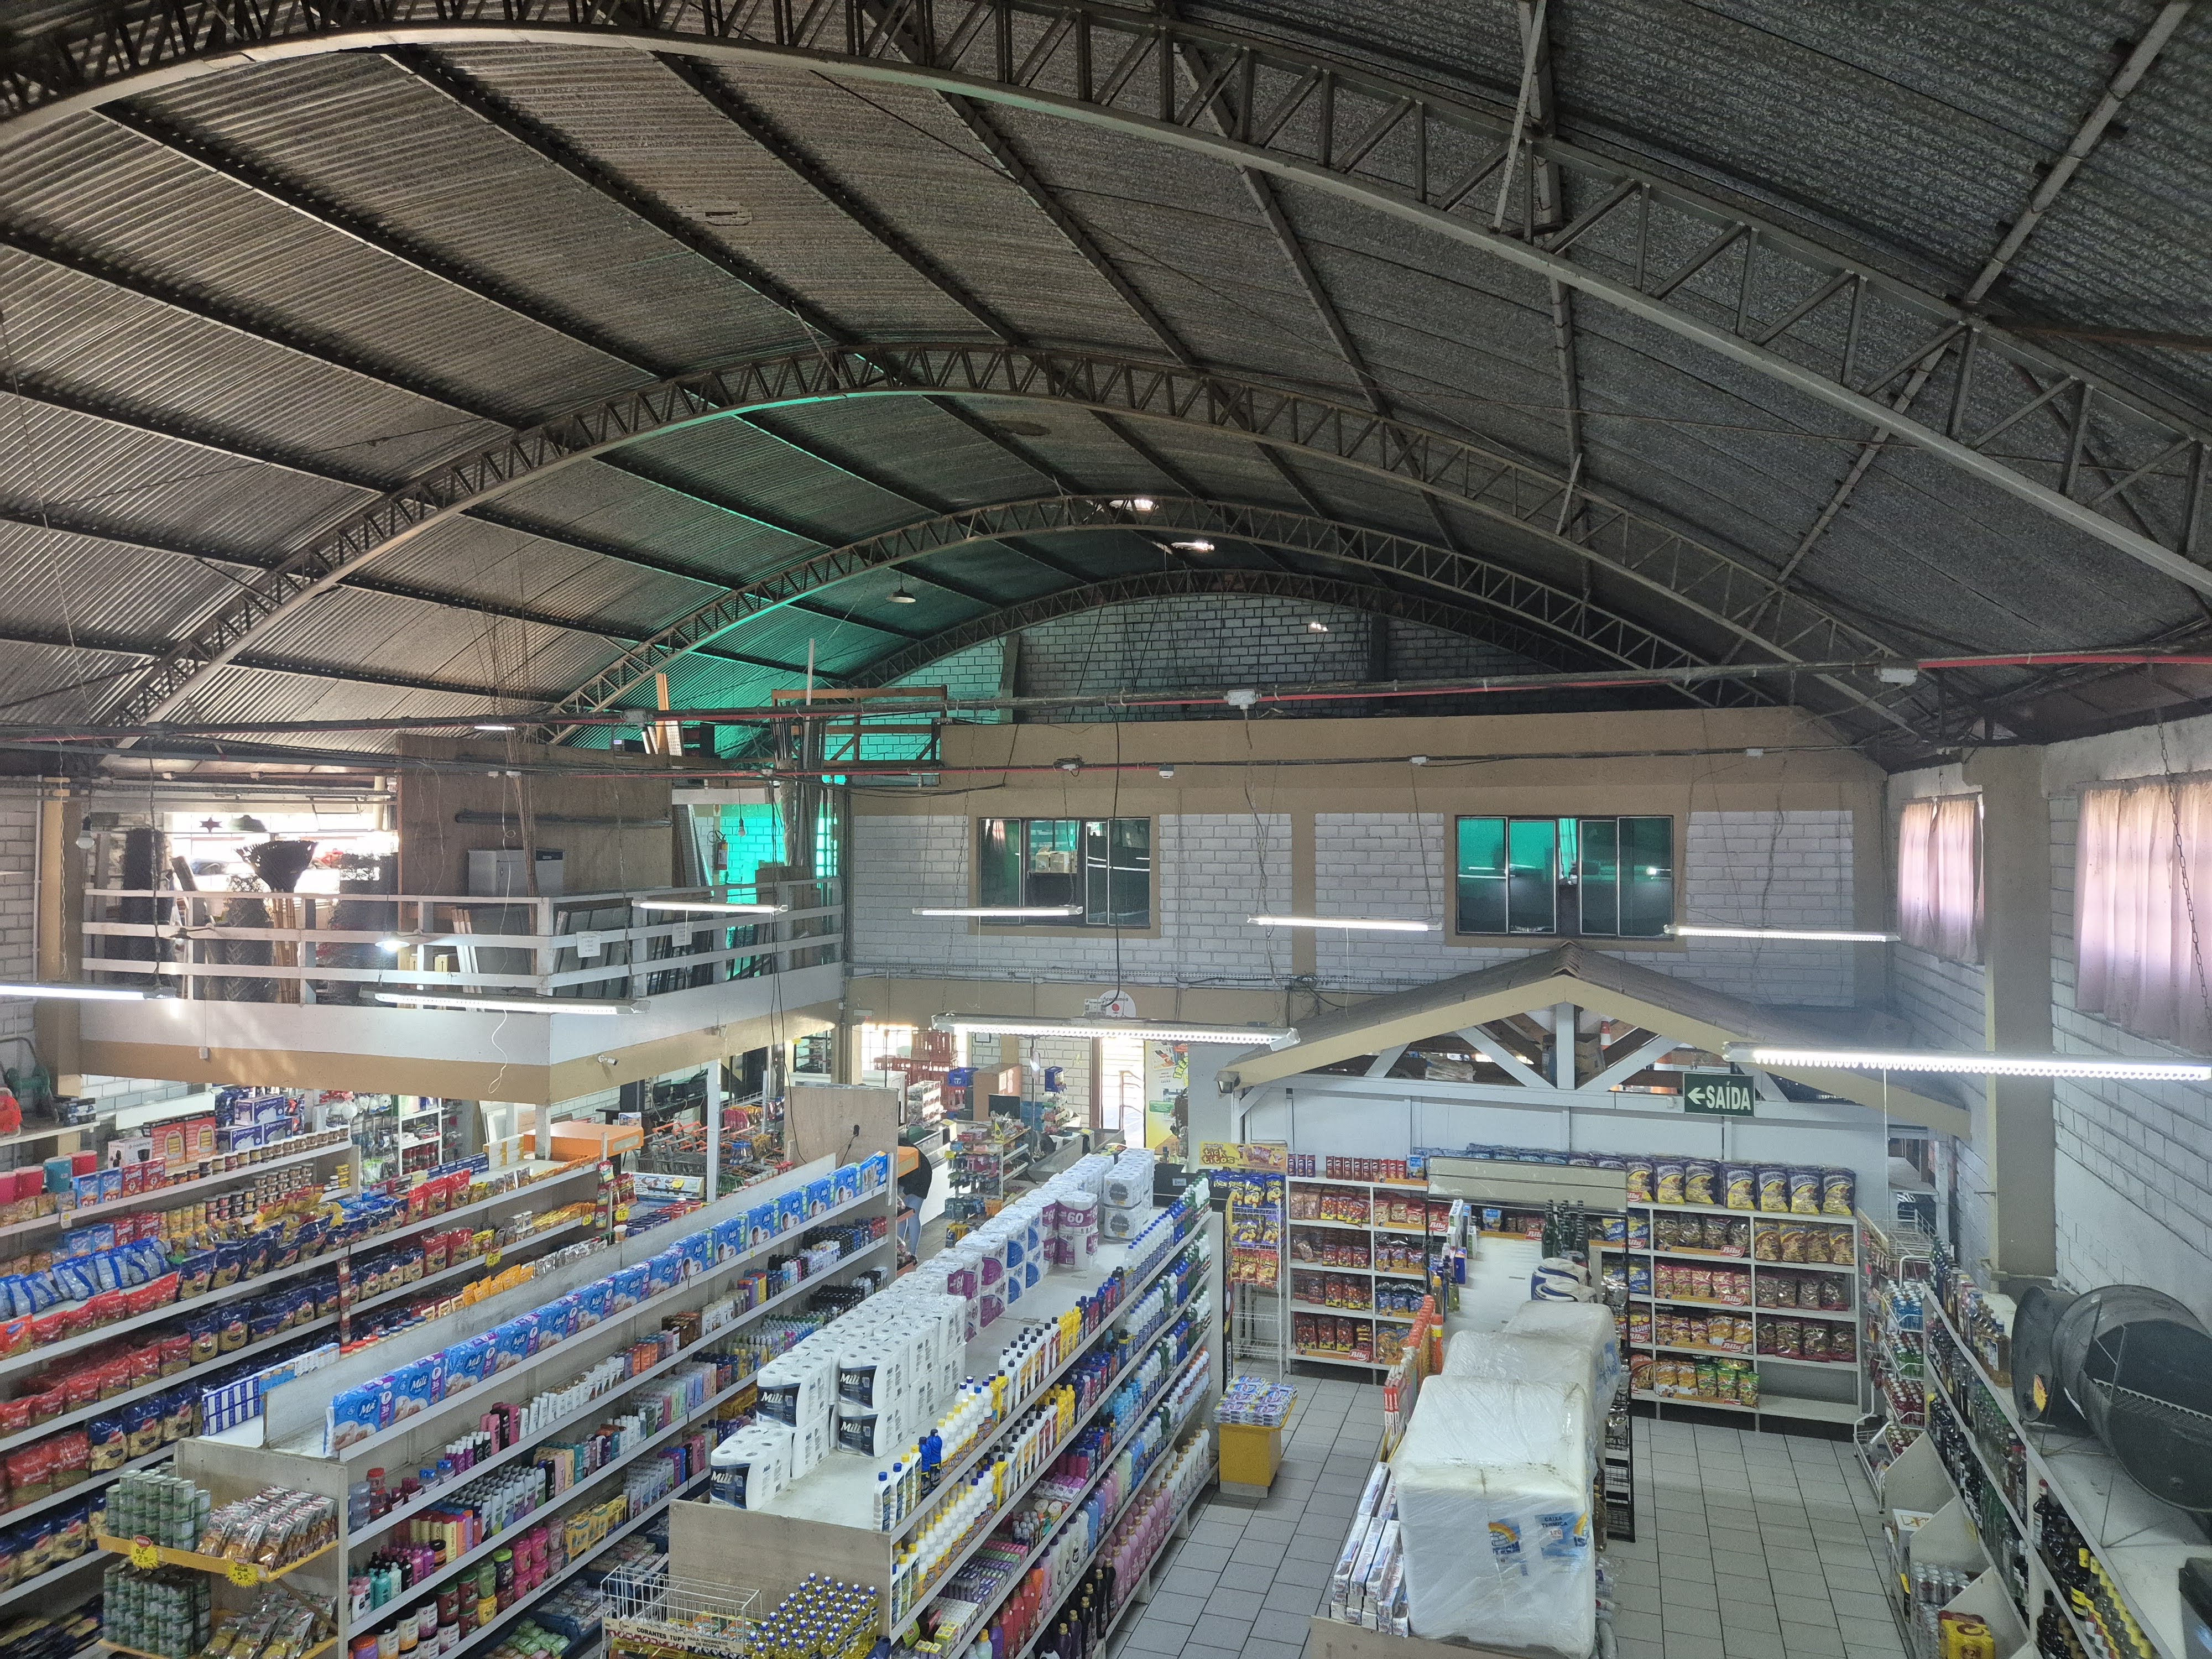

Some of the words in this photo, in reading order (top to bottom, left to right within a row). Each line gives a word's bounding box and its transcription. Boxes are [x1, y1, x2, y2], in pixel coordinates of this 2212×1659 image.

[1706, 1081, 1751, 1110] SAÍDA
[1204, 1147, 1226, 1157] tick
[1202, 1155, 1235, 1164] titos
[1067, 1212, 1084, 1224] 60
[485, 1359, 492, 1368] 36
[410, 1375, 428, 1392] Mili
[431, 1381, 440, 1389] 36
[839, 1373, 860, 1385] Mili
[760, 1391, 783, 1404] Mili
[840, 1421, 862, 1434] Mili
[711, 1470, 733, 1484] Mili
[612, 1504, 622, 1513] GOLD
[637, 1627, 667, 1640] CORANTES
